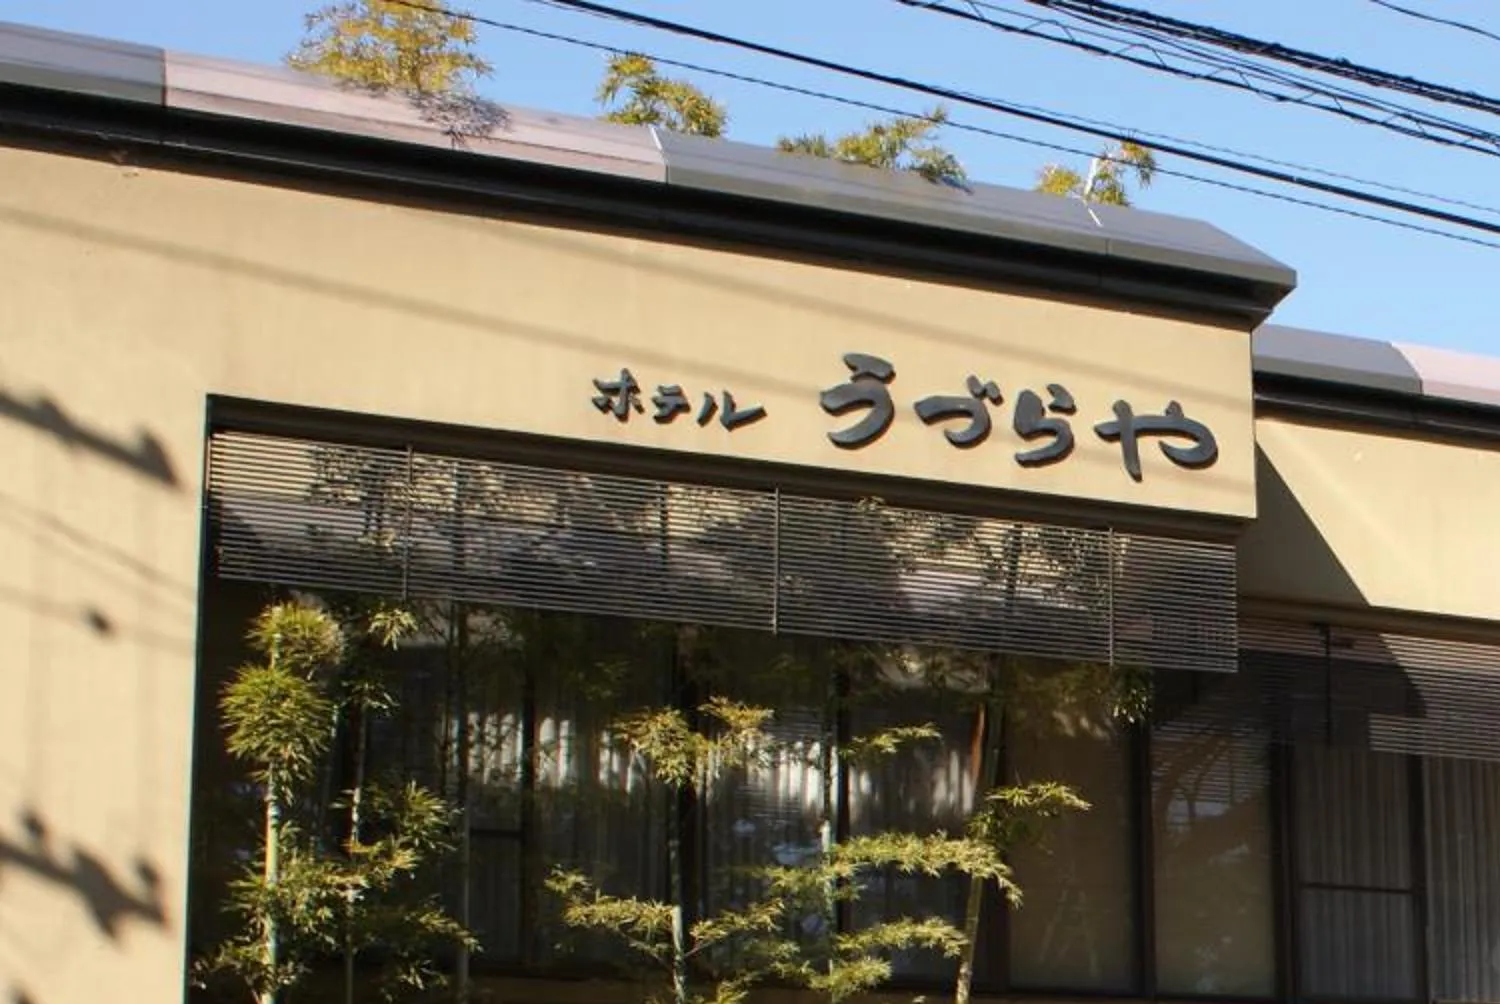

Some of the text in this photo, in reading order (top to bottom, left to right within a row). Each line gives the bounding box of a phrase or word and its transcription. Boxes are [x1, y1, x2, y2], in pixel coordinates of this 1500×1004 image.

[591, 352, 1220, 483] ホテル うづらや
